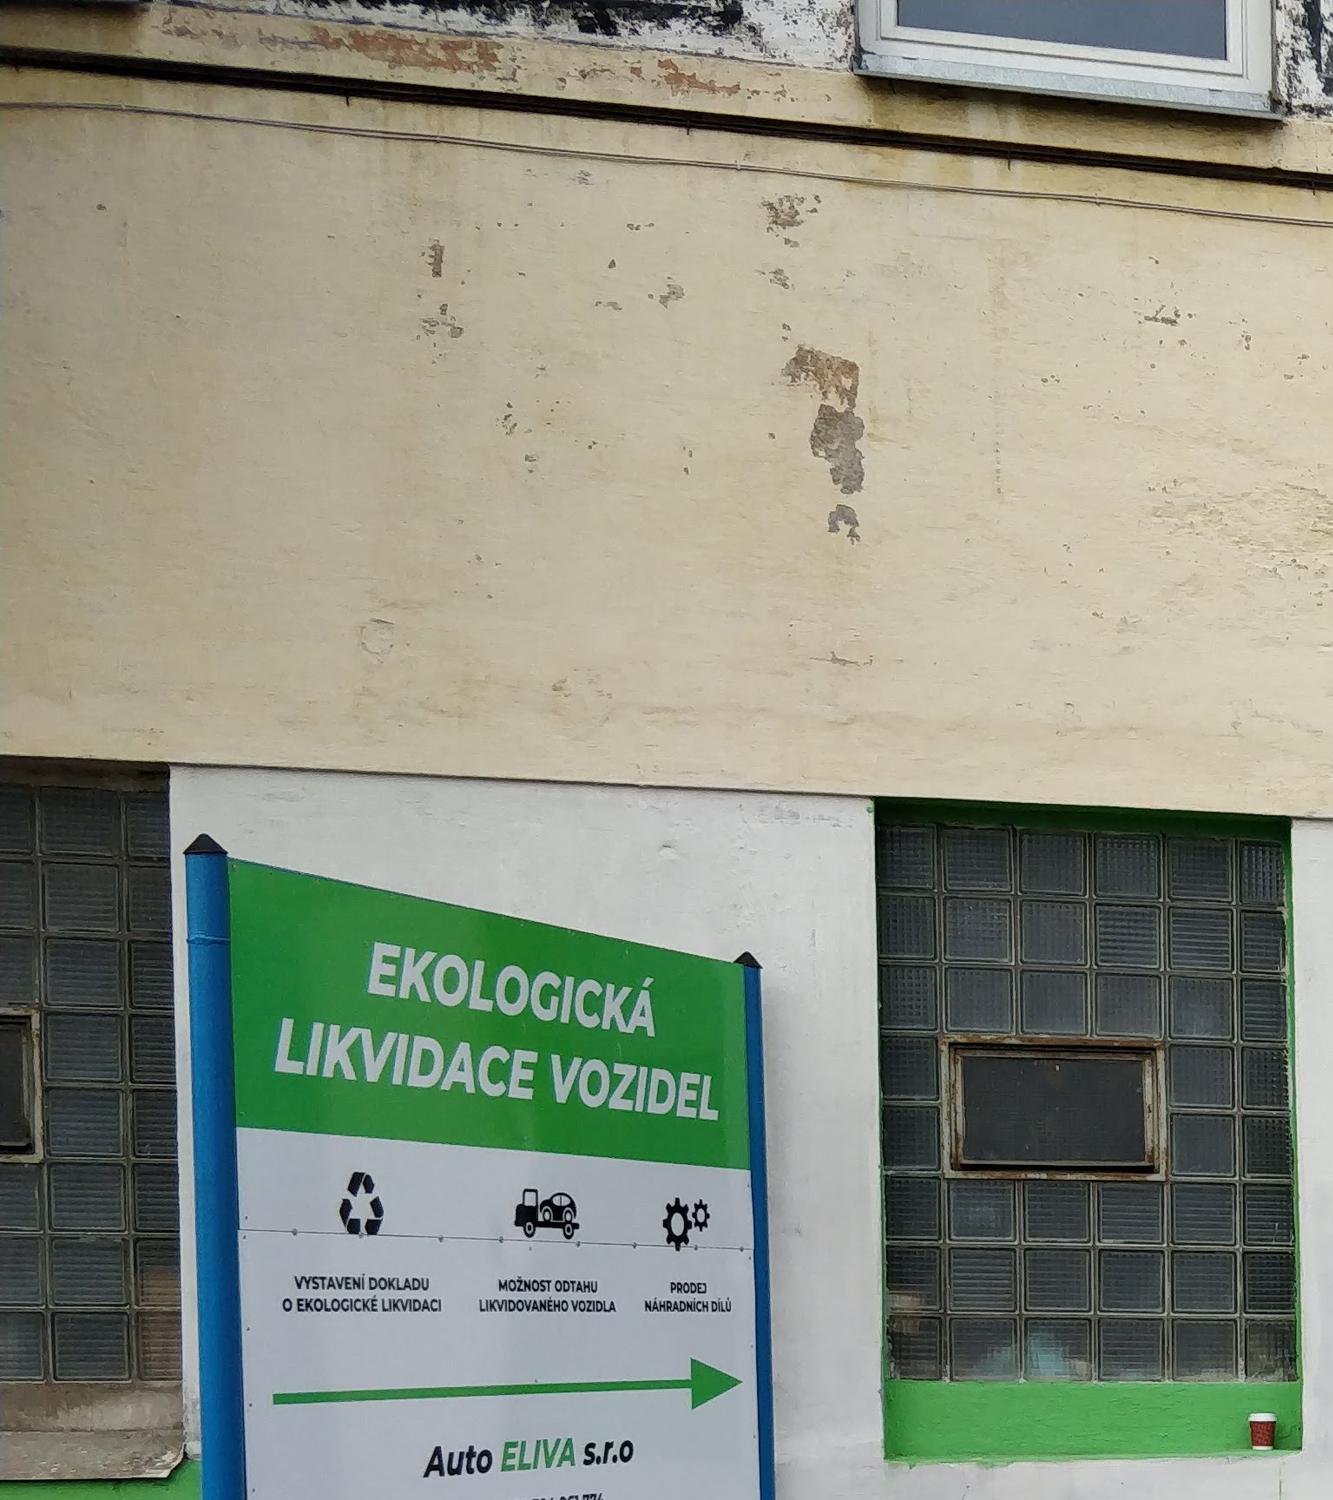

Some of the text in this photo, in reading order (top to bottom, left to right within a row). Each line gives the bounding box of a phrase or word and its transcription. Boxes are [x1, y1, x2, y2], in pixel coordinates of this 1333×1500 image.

[368, 941, 655, 1038] EKOLOGICKÁ
[274, 1018, 719, 1122] LIKVIDACE VOZIDEL
[294, 1274, 430, 1292] VYSTAVENÍ DOKLADU
[498, 1276, 599, 1294] MOŽNOST ODTAHU
[670, 1282, 707, 1294] PRODEJ
[282, 1295, 442, 1313] O EKOLOGICKÉ LIKVIDACI
[479, 1297, 617, 1313] LIKVIDOVANÉHO VOZIDLA
[644, 1298, 732, 1313] NÁHRADNÍCH DÍLŮ
[423, 1437, 634, 1478] Auto ELIVA s.r.o
